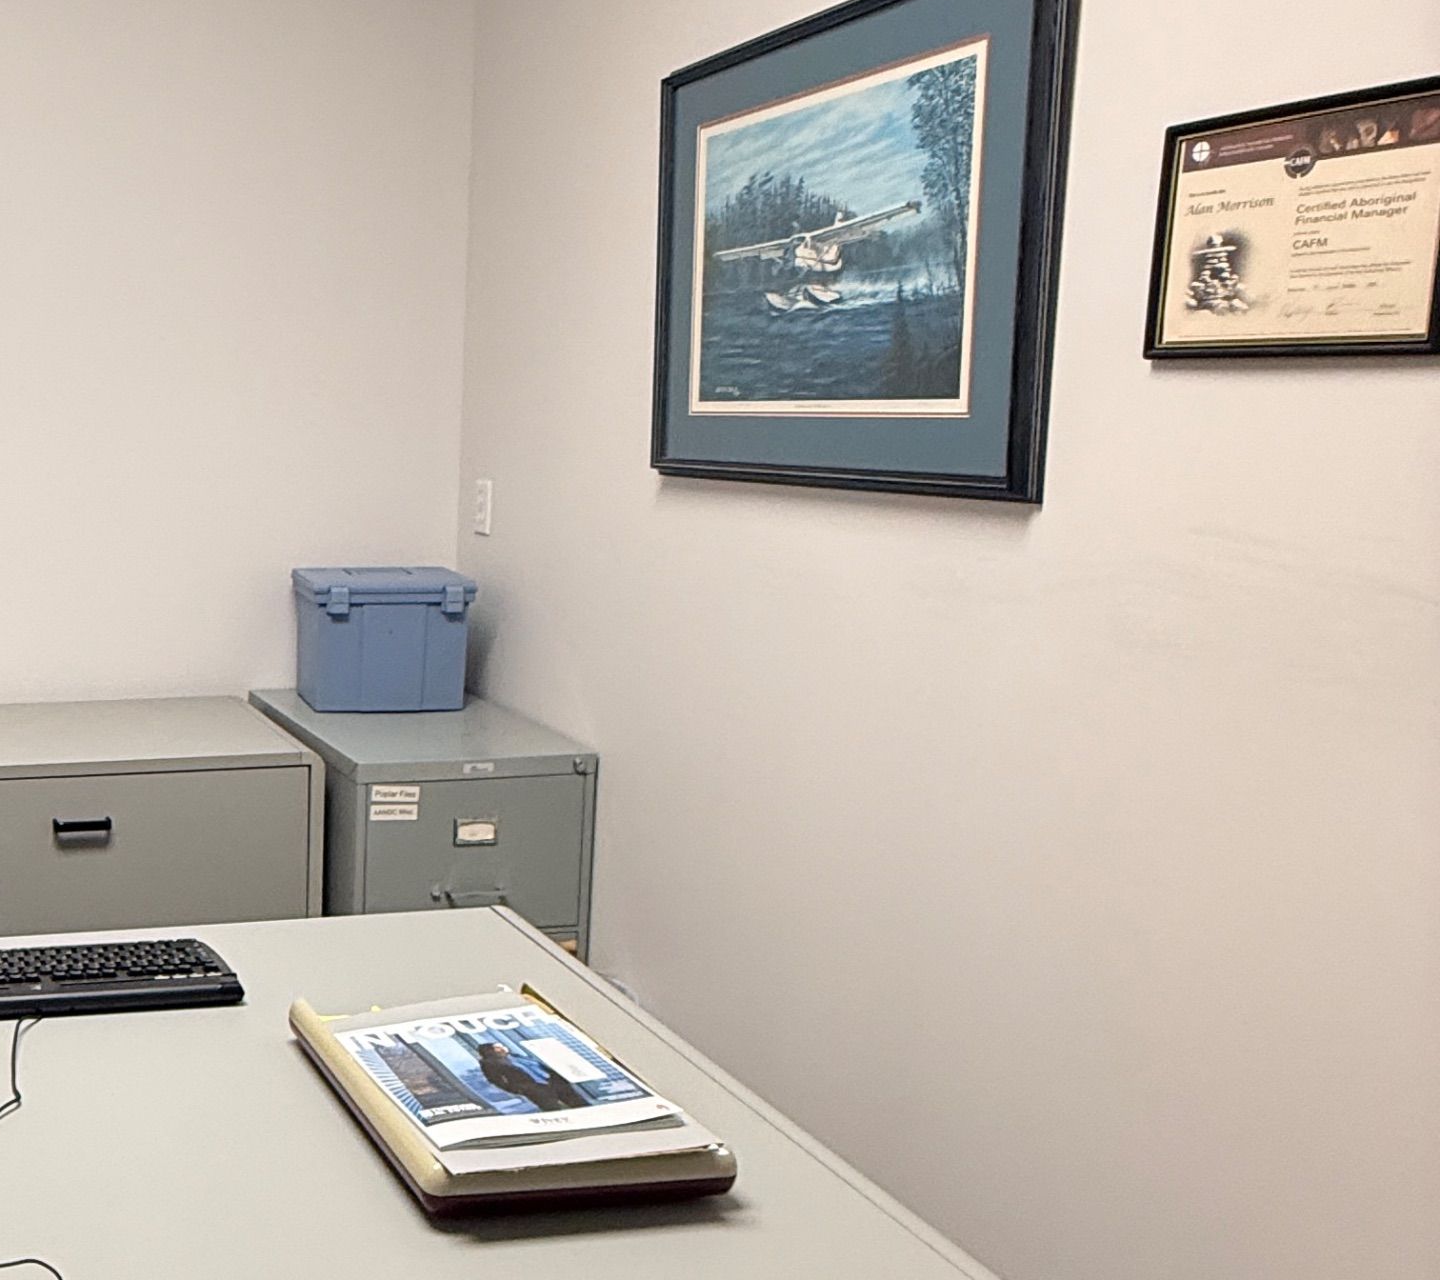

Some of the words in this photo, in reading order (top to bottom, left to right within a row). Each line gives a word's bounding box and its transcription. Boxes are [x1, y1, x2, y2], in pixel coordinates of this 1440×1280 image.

[1216, 197, 1275, 214] Morrison
[1295, 199, 1347, 214] Certified
[1349, 191, 1417, 207] Aboriginal
[1294, 211, 1348, 226] Financial
[1350, 206, 1409, 219] Manager
[1292, 237, 1329, 251] CAFM
